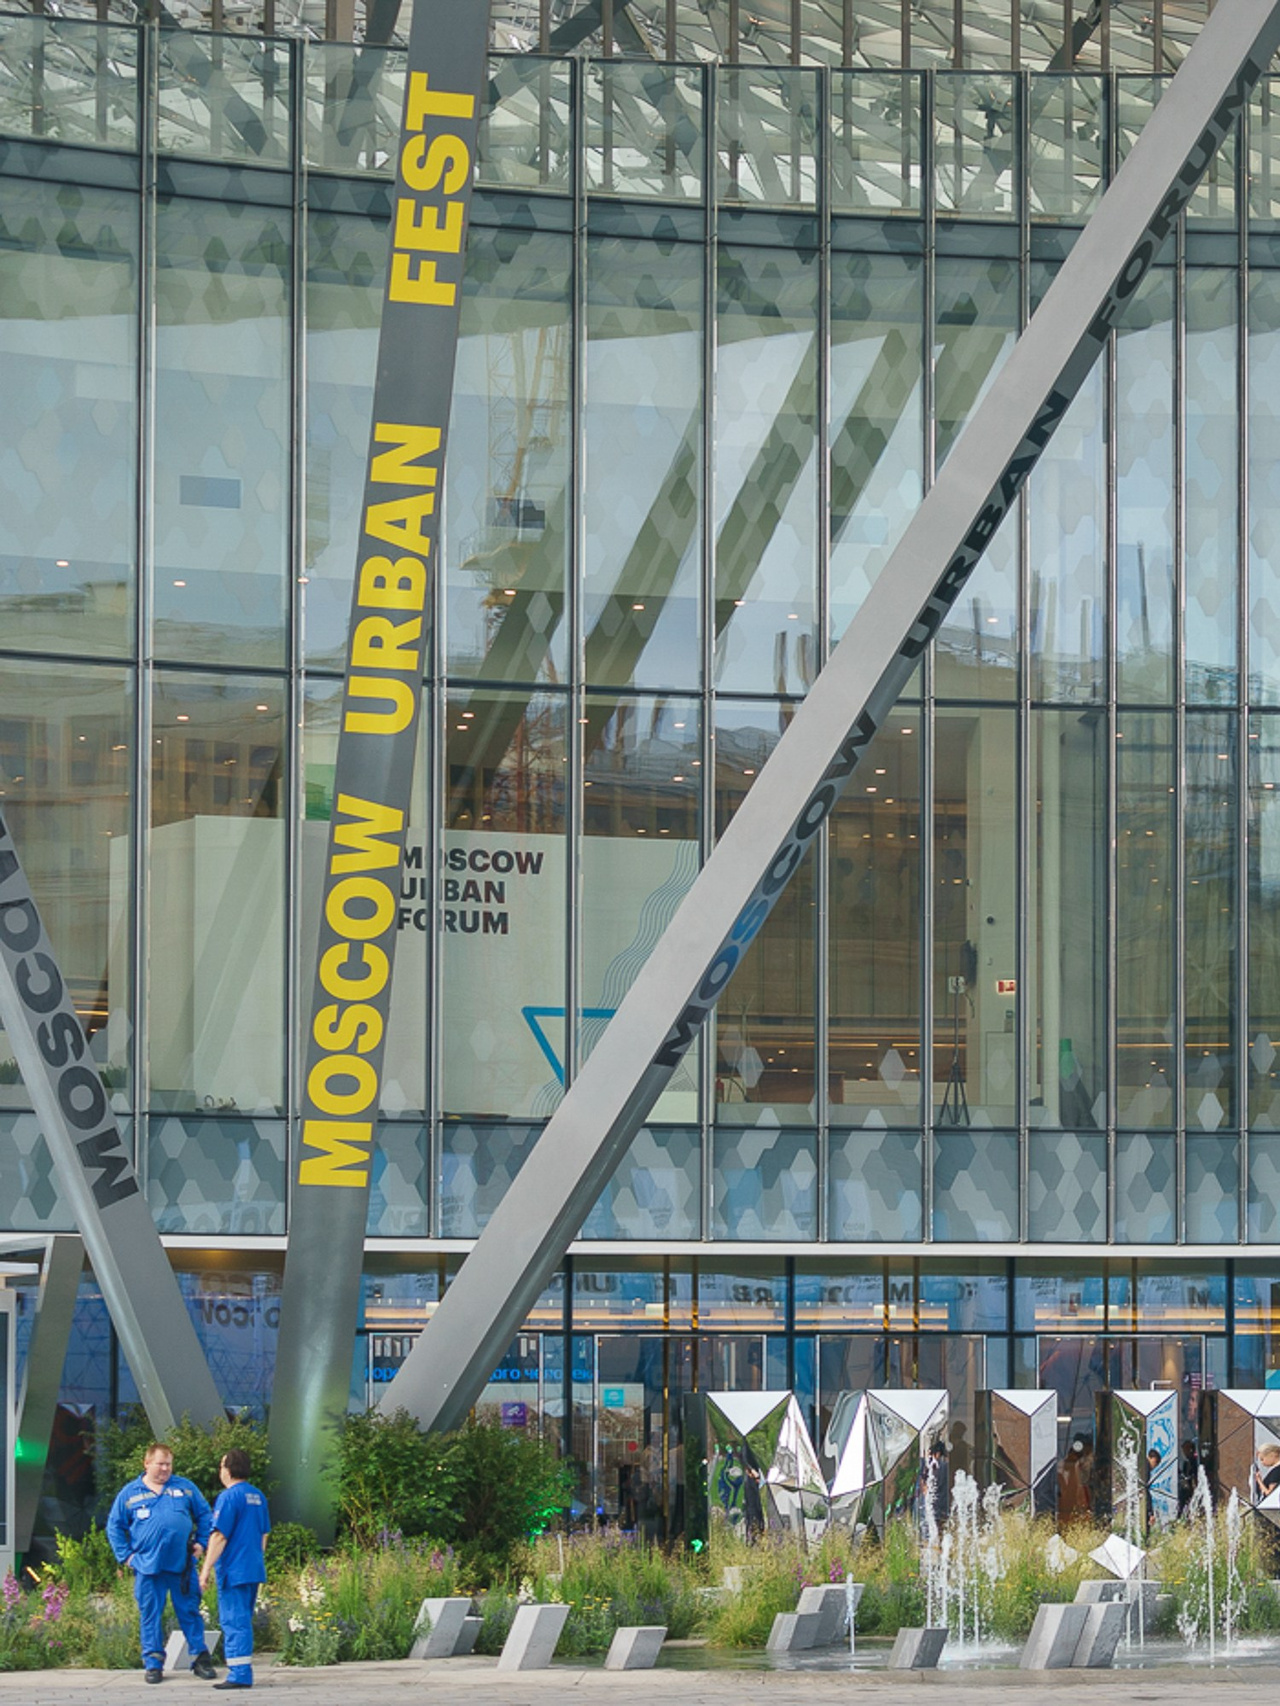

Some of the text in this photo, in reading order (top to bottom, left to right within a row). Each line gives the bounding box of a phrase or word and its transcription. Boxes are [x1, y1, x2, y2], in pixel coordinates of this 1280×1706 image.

[299, 71, 475, 1187] MOSCOW URBAN FEST
[403, 845, 544, 875] MSCOW
[654, 57, 1262, 1067] MOSCOW URBAN FORUM
